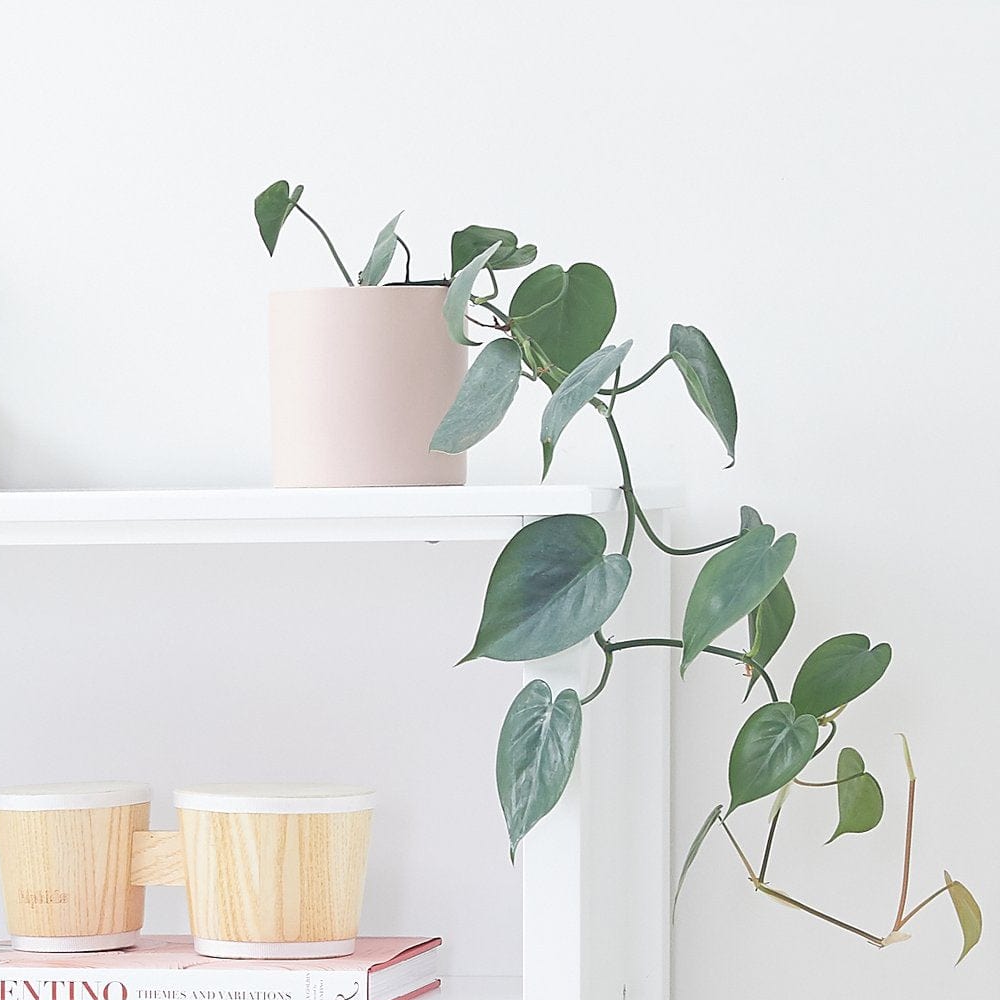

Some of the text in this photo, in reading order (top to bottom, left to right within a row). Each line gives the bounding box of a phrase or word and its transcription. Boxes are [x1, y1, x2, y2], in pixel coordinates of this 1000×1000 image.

[136, 990, 187, 1000] THEMES
[191, 990, 216, 1000] AND
[217, 991, 293, 1000] VARIATIONS
